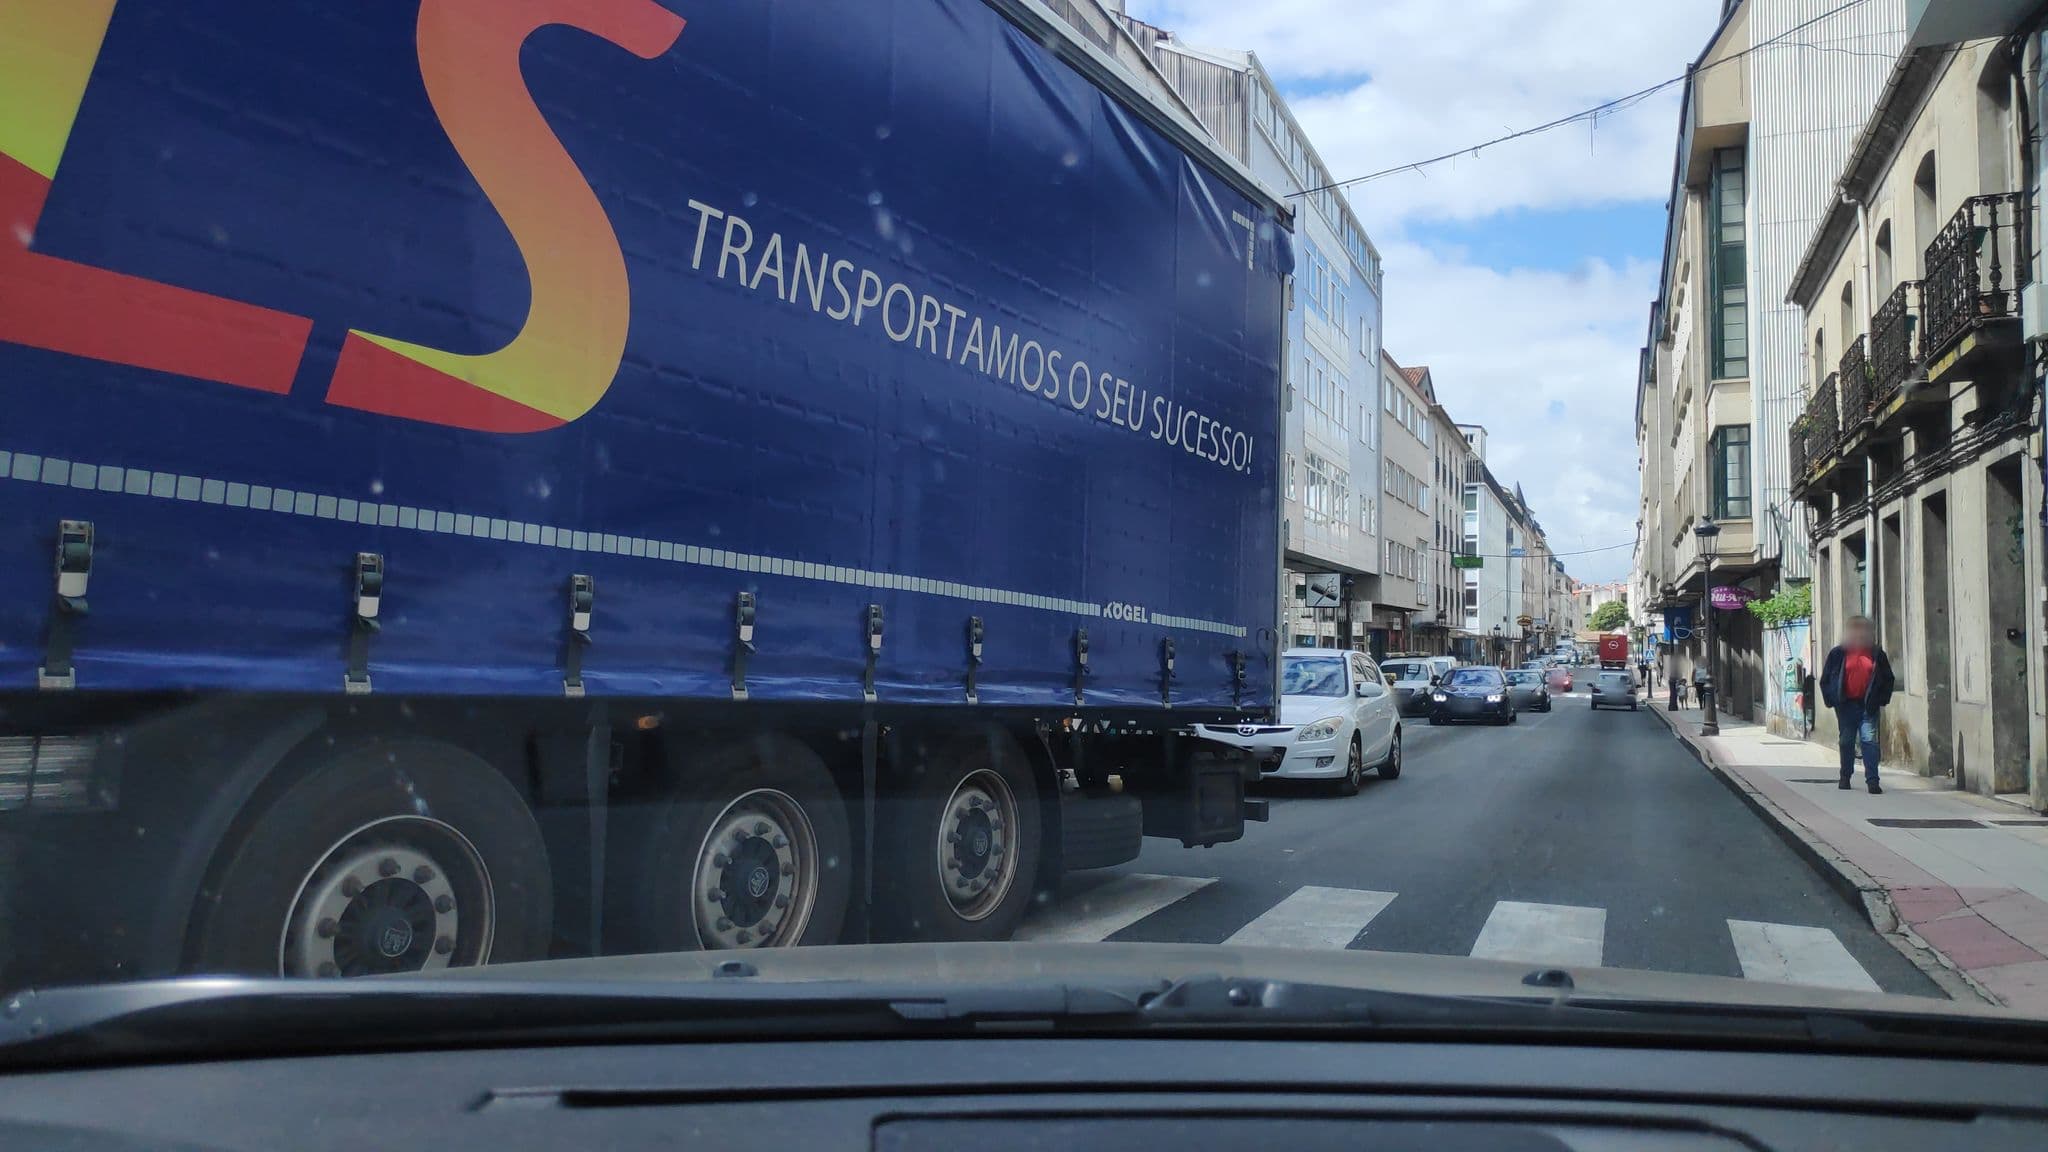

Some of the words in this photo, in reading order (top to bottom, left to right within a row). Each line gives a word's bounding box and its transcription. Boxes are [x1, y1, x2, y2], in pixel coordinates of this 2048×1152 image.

[688, 198, 1062, 400] TRANSPORTAMOS
[1068, 360, 1091, 411] O
[1096, 372, 1147, 432] SEU
[1150, 396, 1254, 475] SUCESSO!
[1103, 601, 1148, 624] KÖGEL
